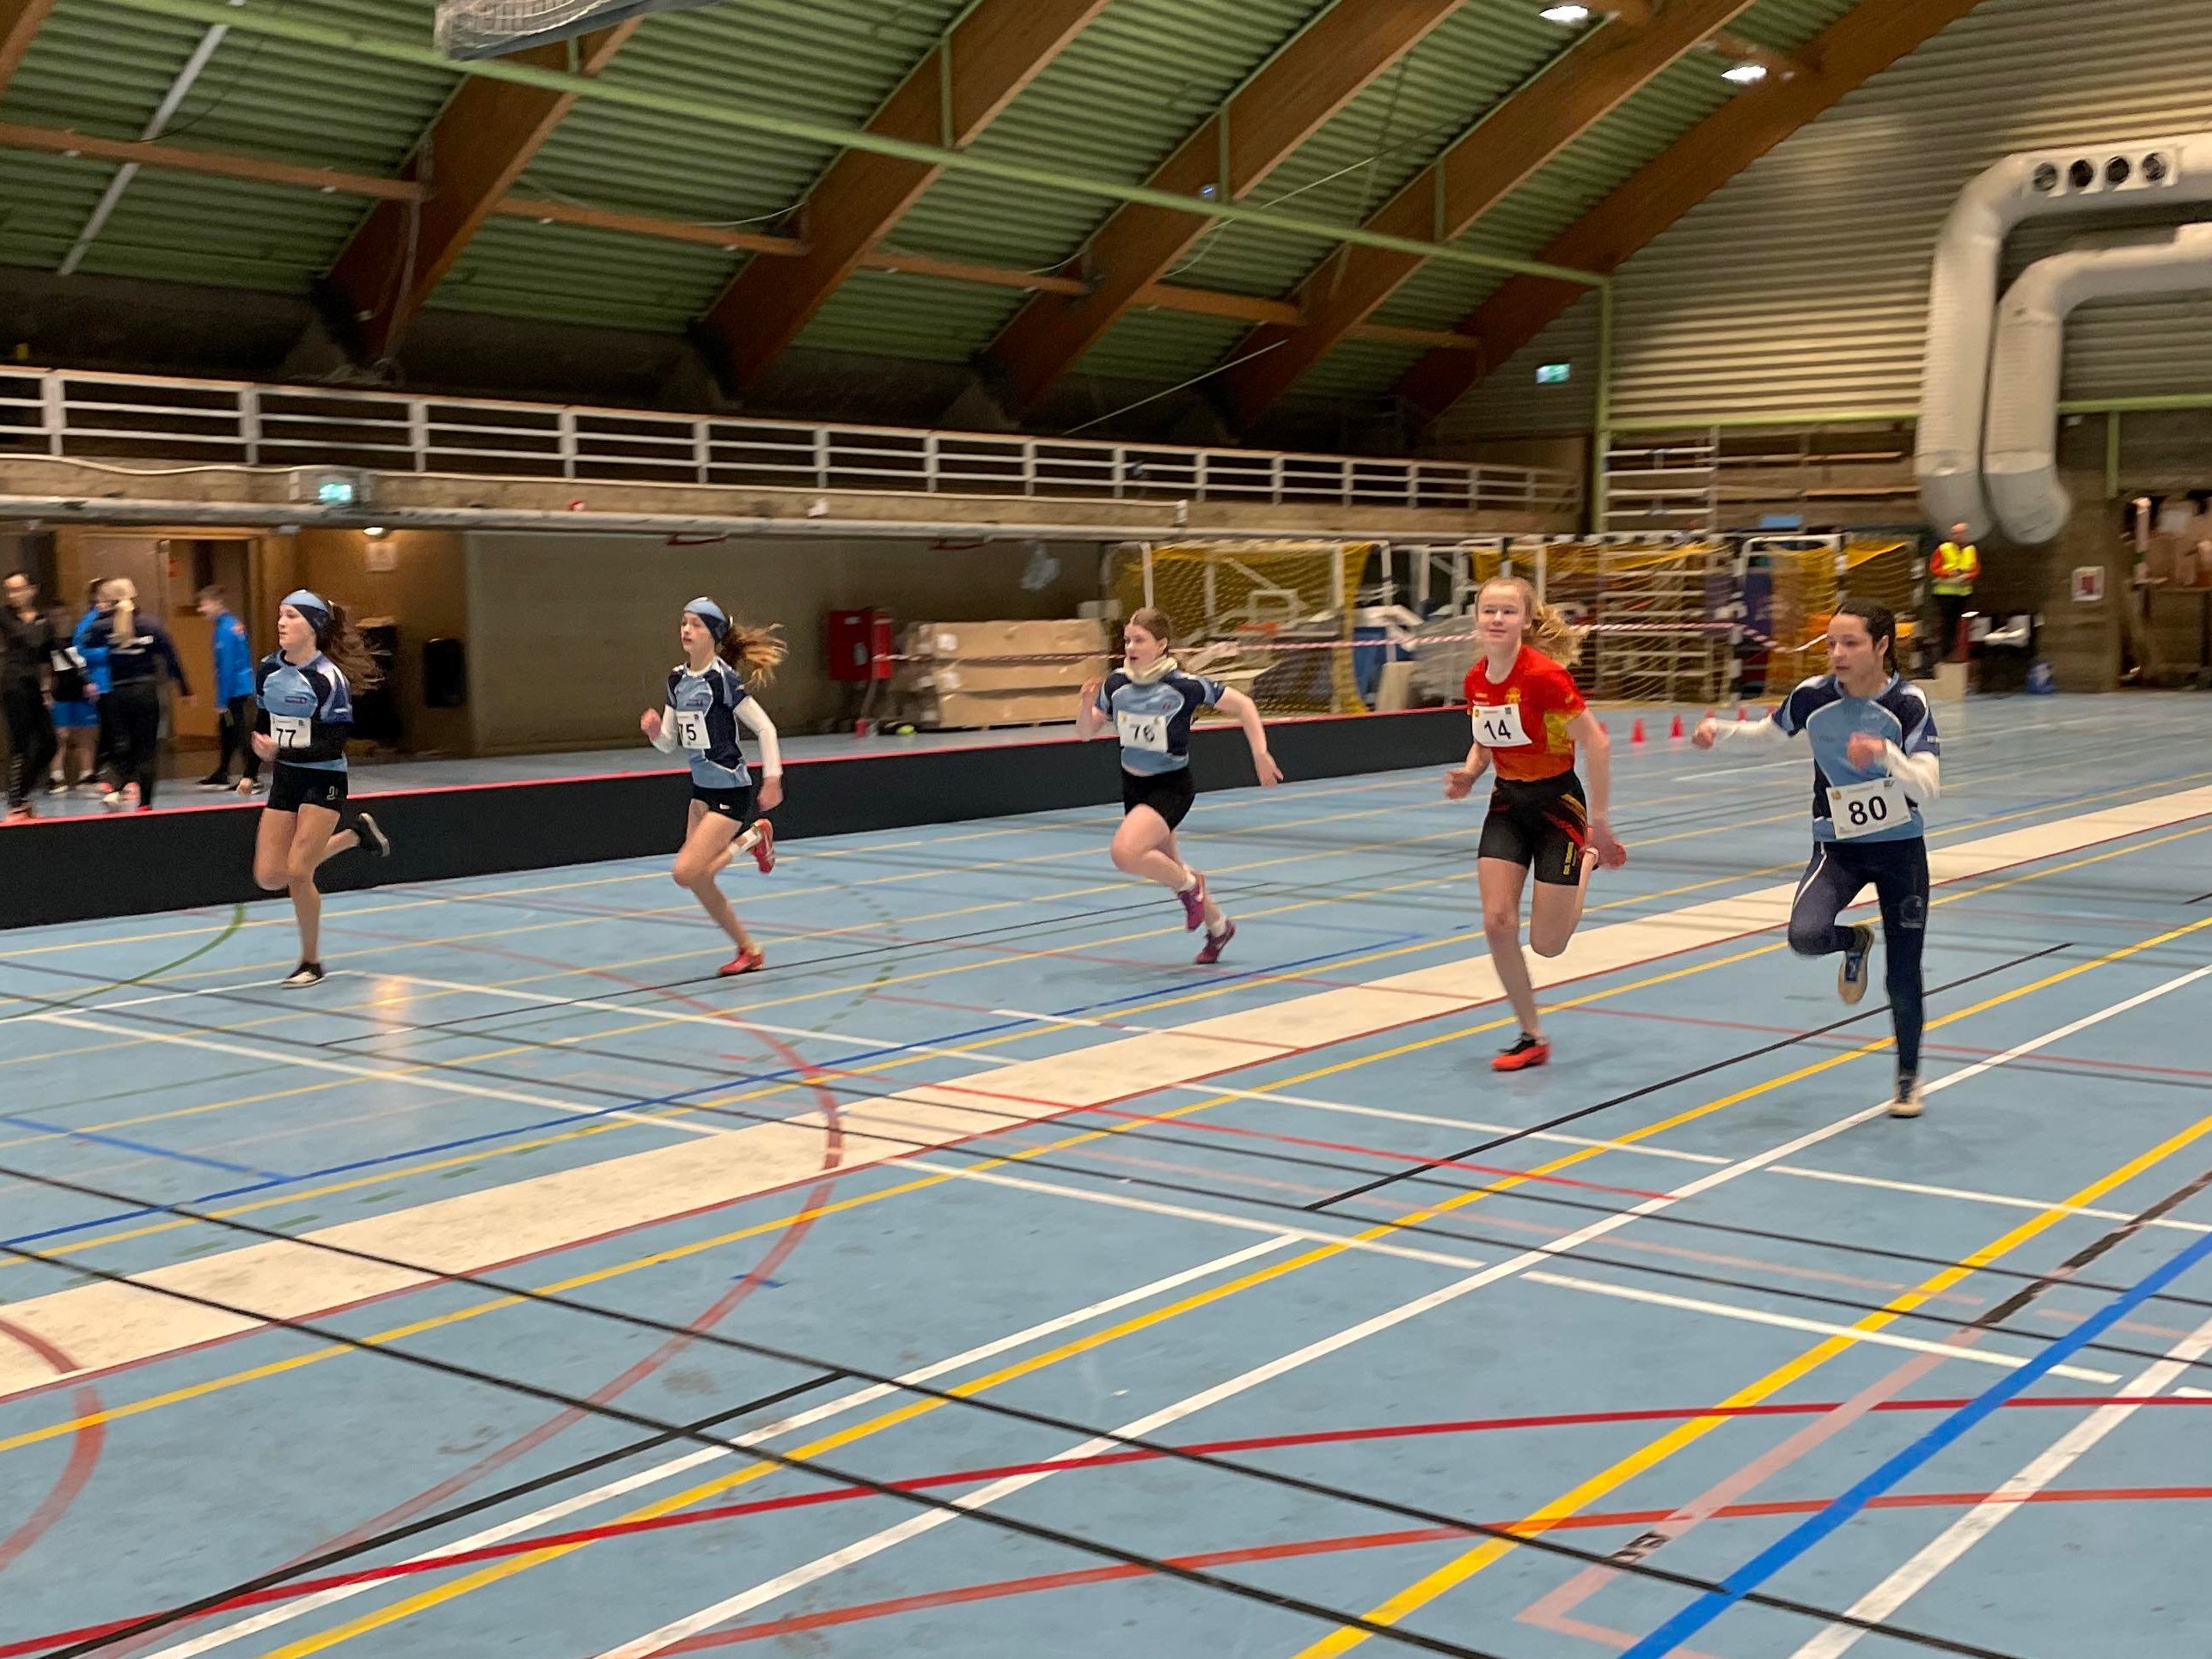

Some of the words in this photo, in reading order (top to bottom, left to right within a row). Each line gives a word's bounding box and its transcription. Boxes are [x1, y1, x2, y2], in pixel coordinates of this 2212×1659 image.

[276, 728, 296, 747] 77
[1484, 719, 1511, 740] 14
[1848, 796, 1887, 826] 80
